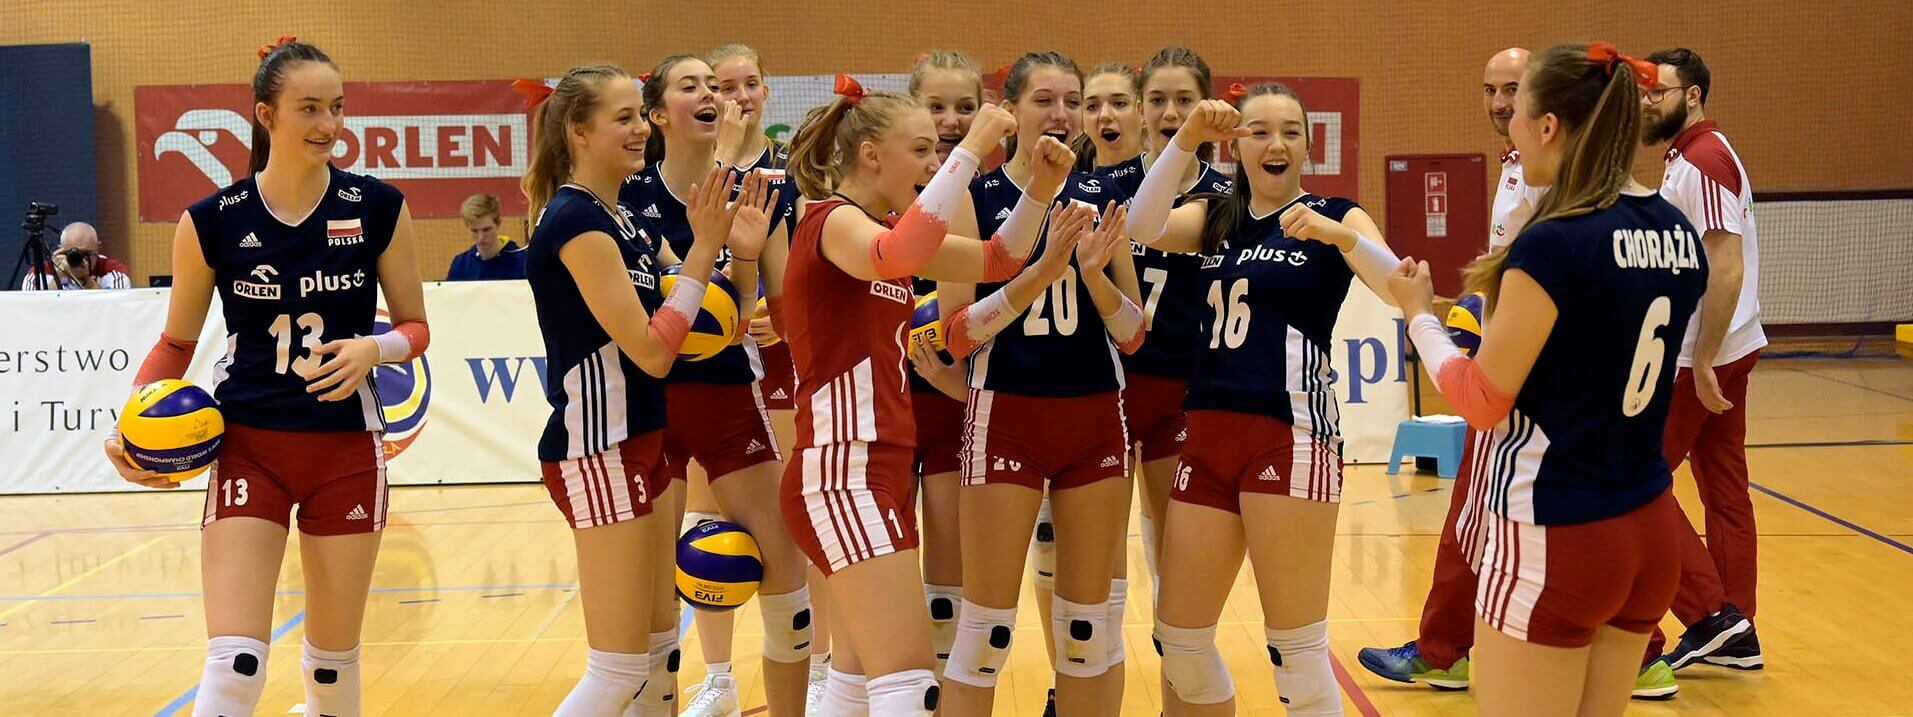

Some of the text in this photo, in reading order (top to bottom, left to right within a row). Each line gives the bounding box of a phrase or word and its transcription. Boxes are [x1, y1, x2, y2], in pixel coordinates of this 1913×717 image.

[330, 124, 513, 171] ORLEN
[219, 193, 241, 211] plus
[339, 190, 361, 201] ORLEN
[328, 235, 364, 247] POLSKA
[1236, 244, 1286, 266] plus
[1612, 224, 1700, 275] CHORĄŻA
[235, 282, 278, 297] ORLEN
[300, 269, 352, 298] plus
[873, 282, 906, 302] ORLEN
[1023, 264, 1079, 336] 20
[1142, 266, 1168, 332] 7
[1206, 277, 1251, 349] 16
[0, 344, 129, 373] erstwo
[267, 312, 325, 378] 13
[1622, 295, 1671, 417] 6
[13, 400, 19, 431] i
[135, 452, 185, 464] CHAMPIONSHIP
[633, 473, 647, 504] 3
[1173, 460, 1193, 492] 16
[222, 477, 249, 507] 13
[701, 524, 719, 533] FIVB
[887, 507, 904, 539] 1
[694, 590, 724, 603] FIVB
